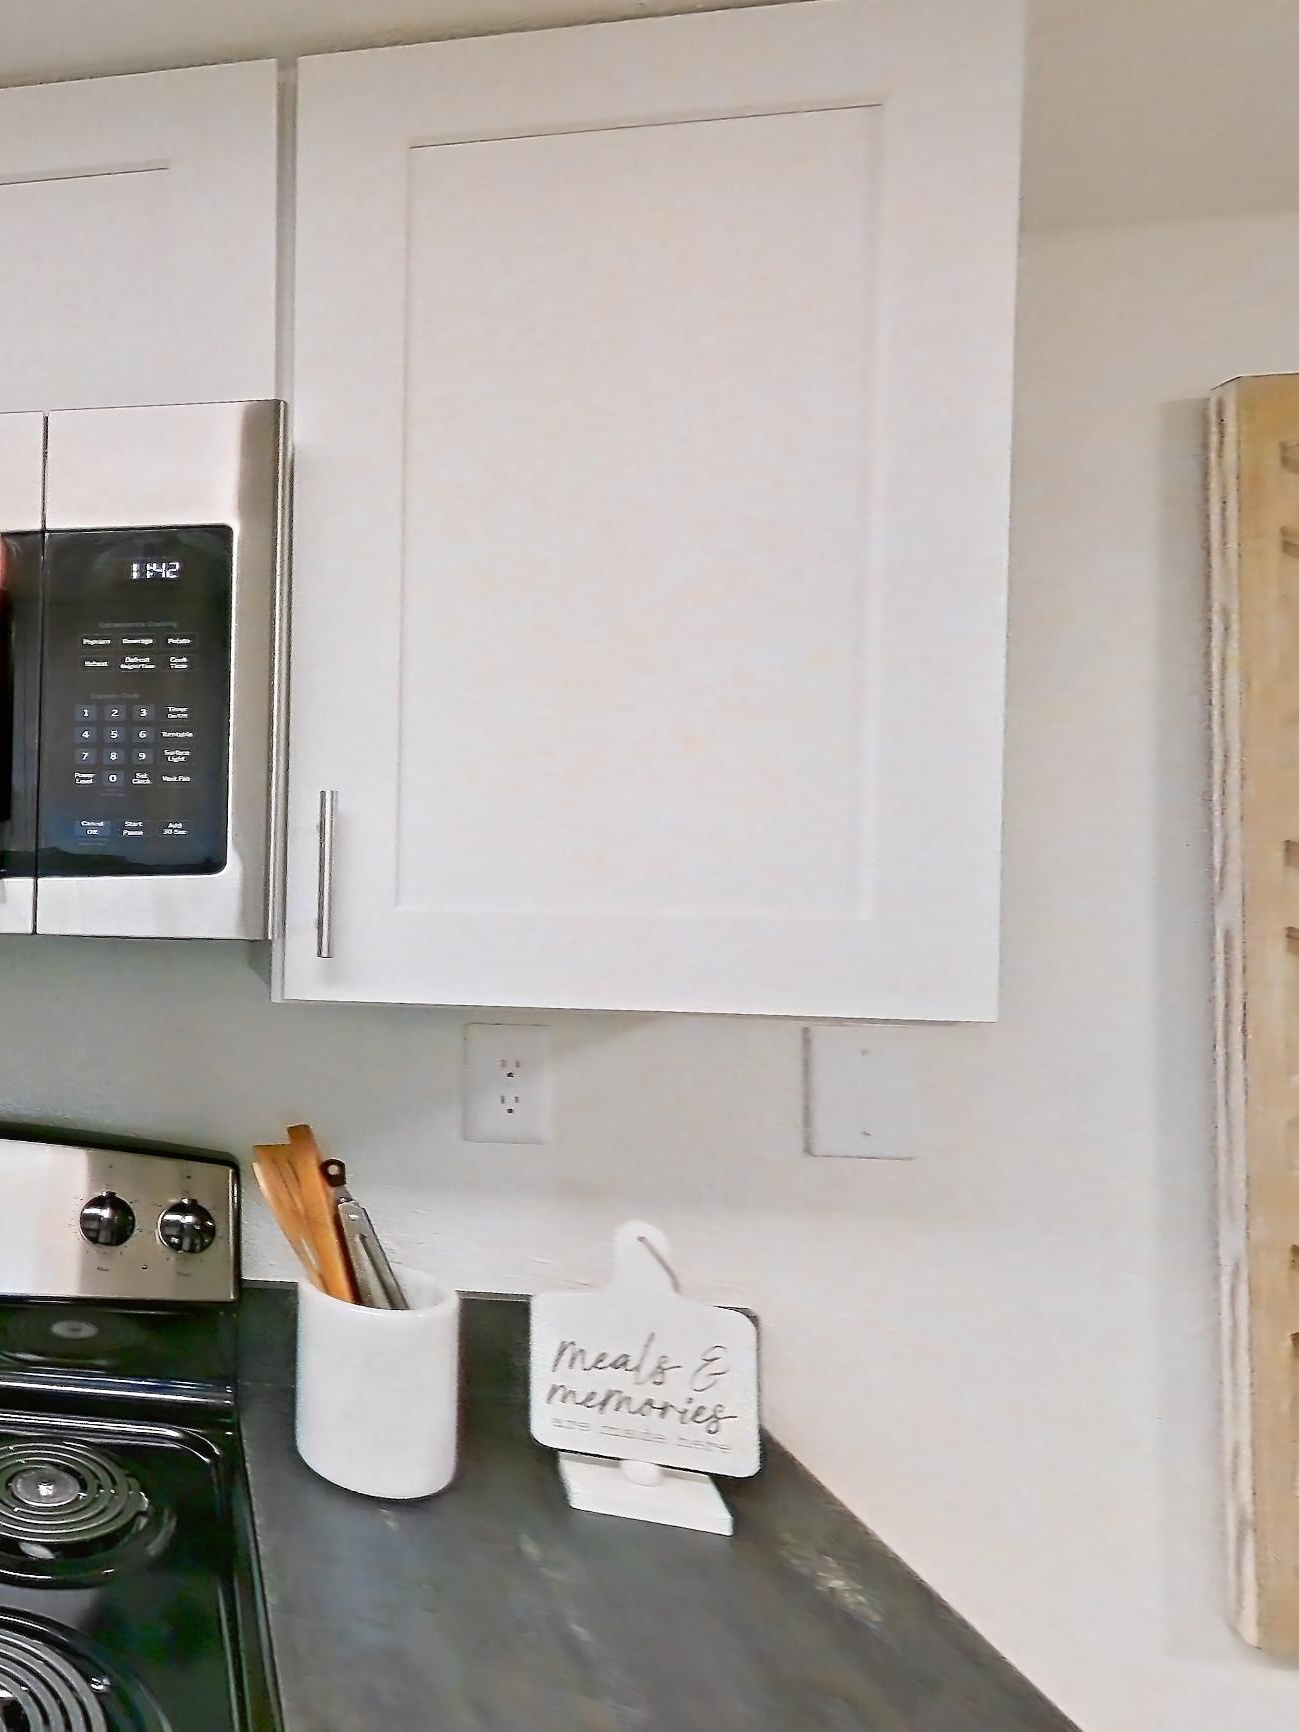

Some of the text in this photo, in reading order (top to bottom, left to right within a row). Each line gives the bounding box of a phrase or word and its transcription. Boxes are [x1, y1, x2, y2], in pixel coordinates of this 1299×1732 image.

[83, 708, 90, 717] 1
[111, 708, 120, 717] 2
[140, 708, 148, 717] 3
[81, 730, 90, 739] 4
[110, 730, 119, 739] 5
[139, 730, 148, 739] 6
[81, 752, 90, 761] 7
[109, 752, 118, 761] 8
[138, 752, 147, 761] 9
[108, 774, 117, 783] 0
[124, 820, 144, 828] Start
[551, 1331, 683, 1386] meals
[546, 1383, 738, 1435] memories
